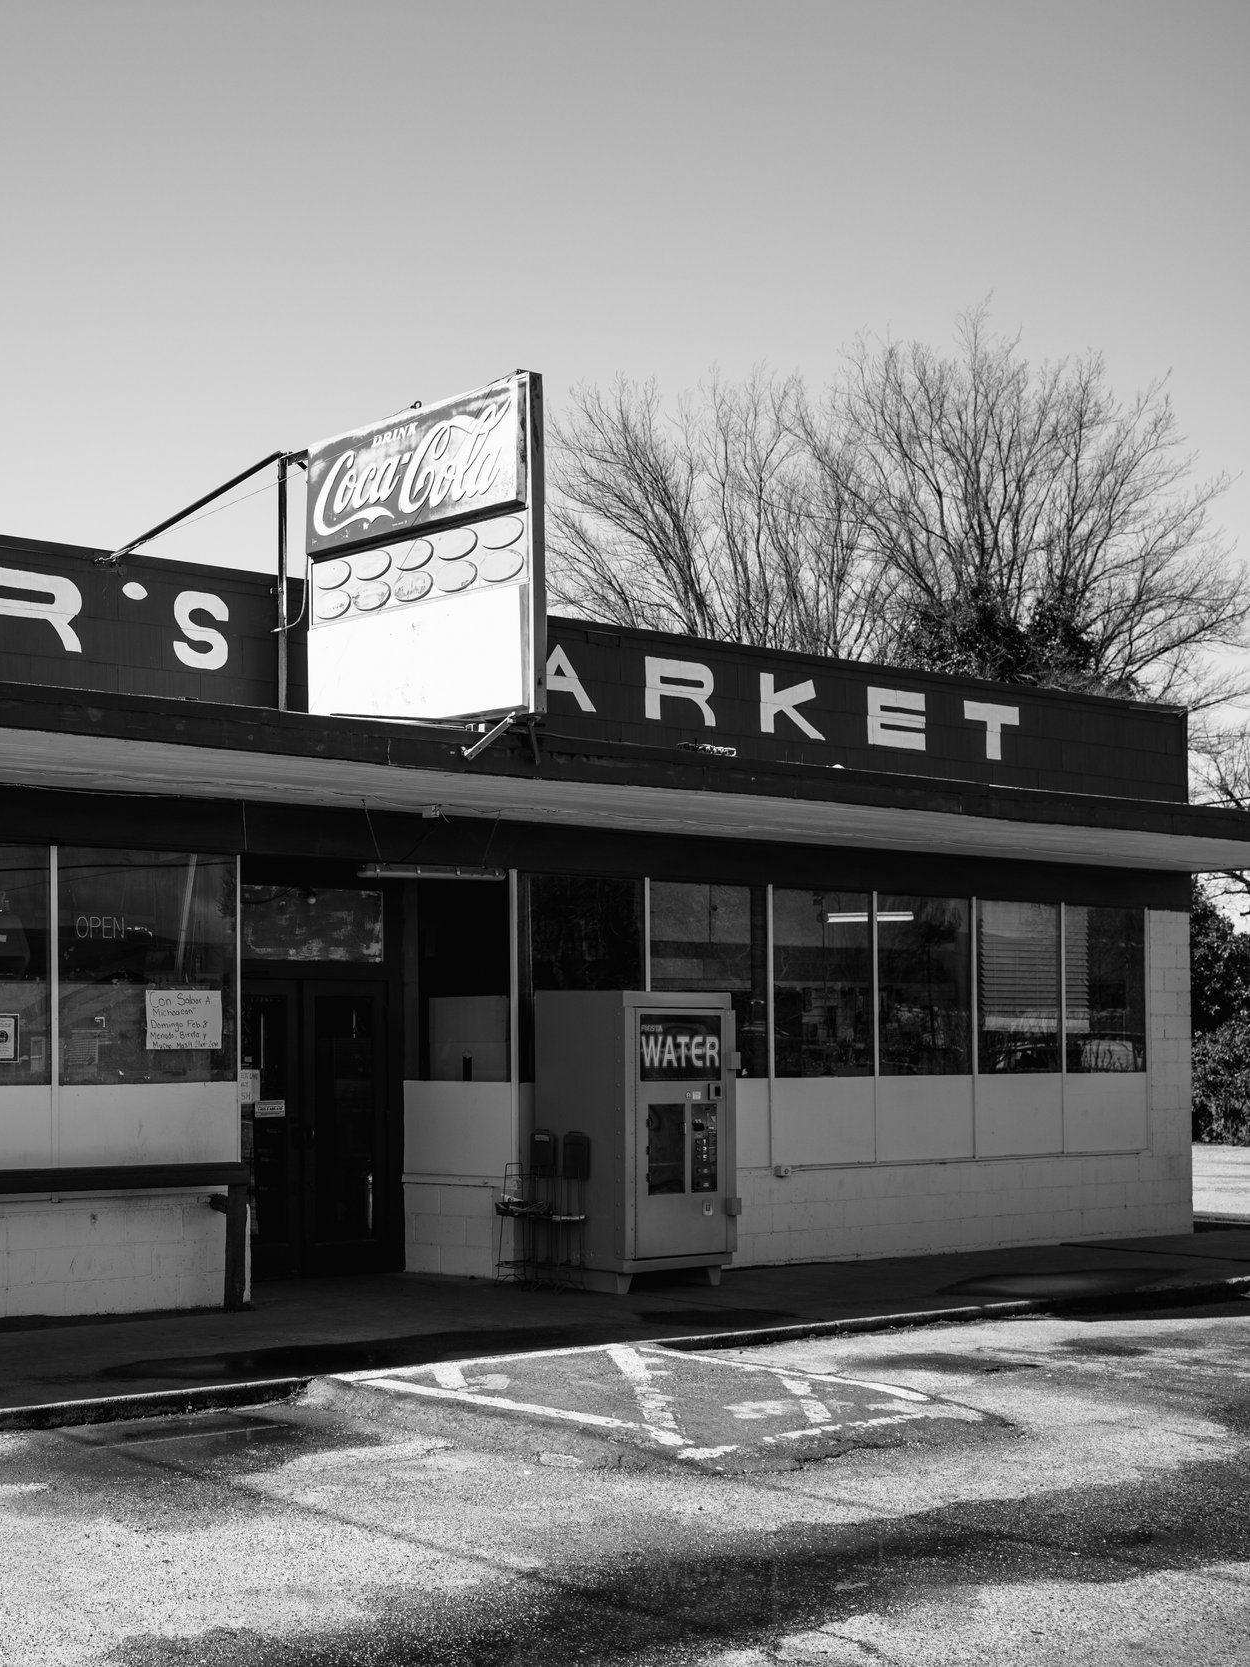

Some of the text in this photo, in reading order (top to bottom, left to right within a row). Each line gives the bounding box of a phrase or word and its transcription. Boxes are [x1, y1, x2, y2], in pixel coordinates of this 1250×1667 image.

[371, 421, 419, 448] DRINK
[313, 395, 511, 536] Coca-Cola
[546, 643, 1020, 760] ARKET
[76, 916, 125, 939] OPEN
[177, 993, 202, 1006] Sabor
[205, 995, 211, 1005] A
[150, 1019, 184, 1033] Domingo
[641, 1034, 720, 1067] WATER
